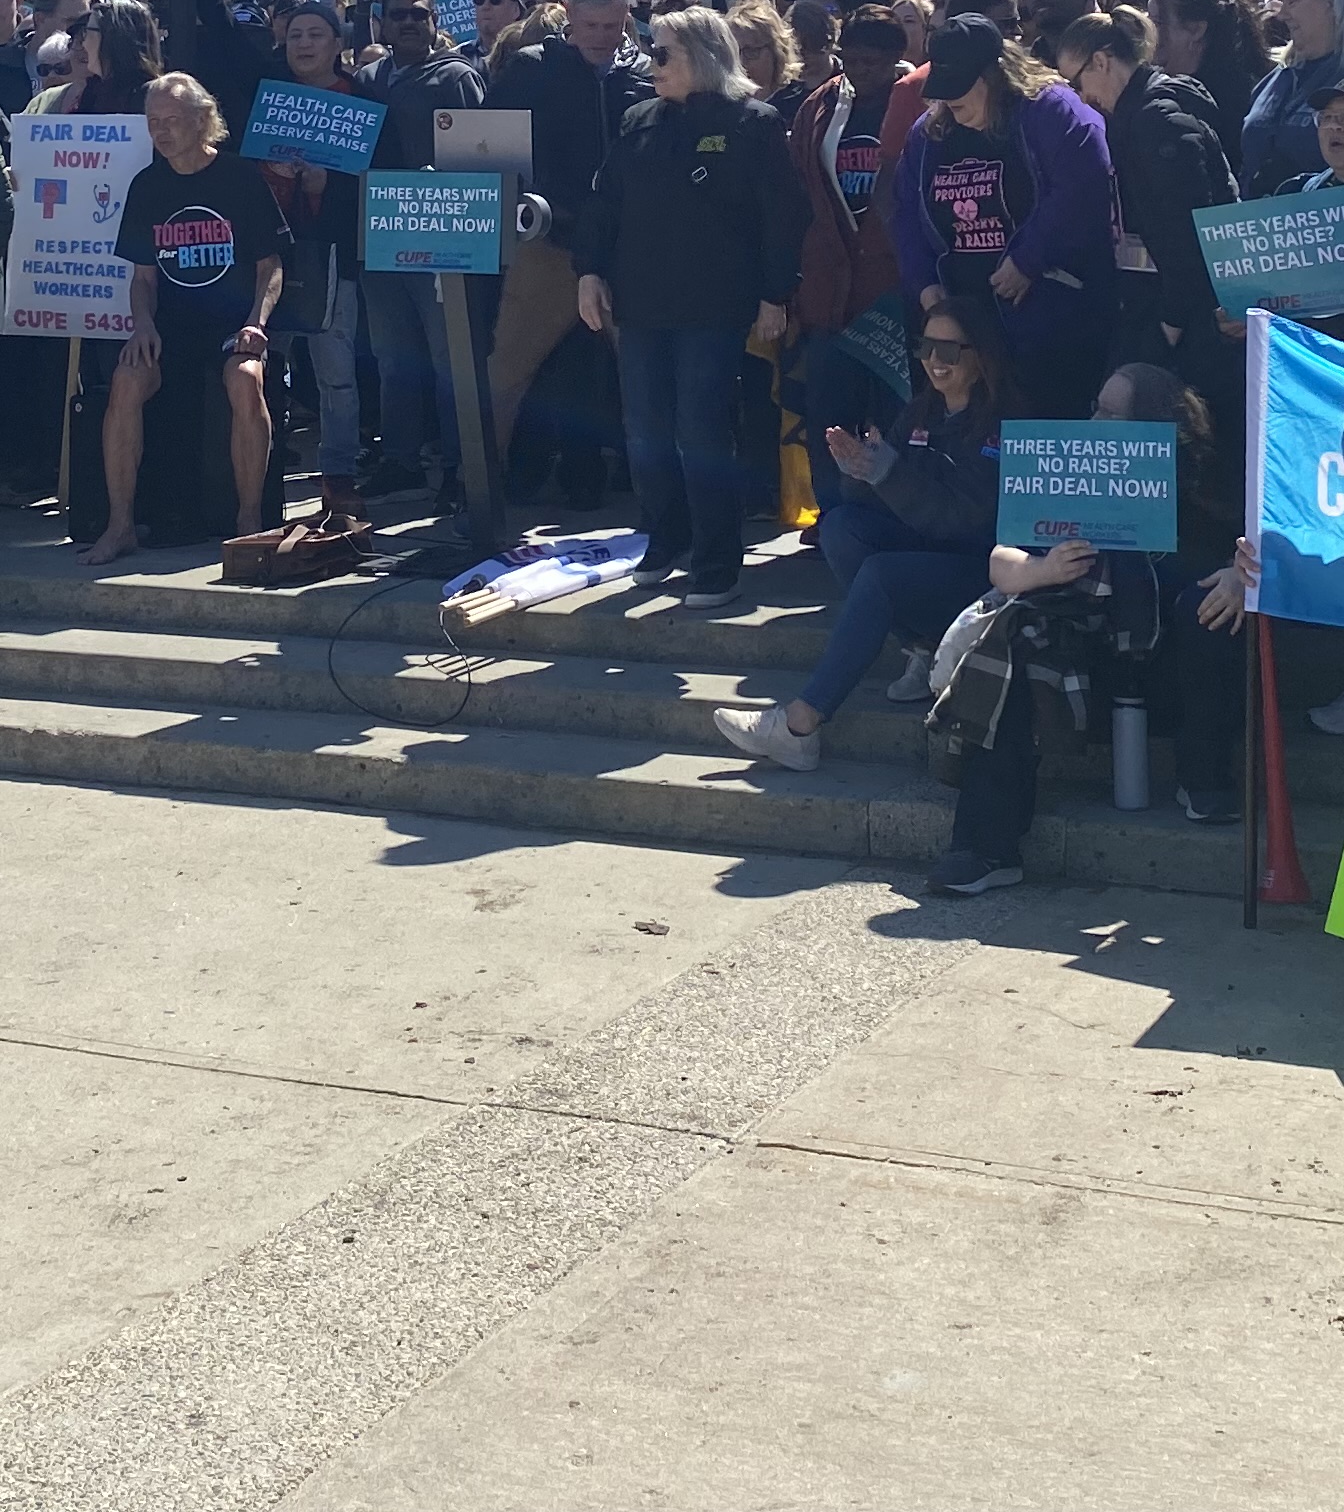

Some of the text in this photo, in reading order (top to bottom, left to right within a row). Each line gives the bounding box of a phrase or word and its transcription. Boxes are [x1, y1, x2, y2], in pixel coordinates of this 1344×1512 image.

[261, 91, 378, 127] HEALTH CARE
[266, 107, 363, 138] PROVIDERS
[31, 124, 132, 143] FAIR DEAL
[252, 122, 314, 141] DESERVE
[314, 132, 325, 143] A
[328, 135, 370, 154] RAISE
[53, 150, 111, 169] NOW!
[934, 169, 999, 187] HEALTH CARE
[370, 186, 498, 202] THREE YEARS WITH
[935, 183, 994, 202] PROVIDERS
[398, 201, 469, 215] NO RAISE?
[153, 219, 232, 247] TOGETHER
[370, 216, 495, 233] FAIR DEAL NOW!
[1201, 219, 1258, 242] THREE
[1260, 210, 1320, 233] YEARS
[35, 239, 115, 255] RESPECT
[966, 231, 1006, 249] RAISE!
[1242, 226, 1335, 254] NO RAISE?
[158, 243, 235, 270] for BETTER
[395, 250, 433, 264] CUPE
[1212, 257, 1256, 279] FAIR
[1260, 252, 1313, 273] DEAL
[22, 260, 127, 279] HEALTHCARE
[33, 280, 114, 299] WORKERS
[13, 309, 68, 330] CUPE
[1004, 439, 1171, 458] THREE YEARS WITH
[1037, 457, 1130, 475] NO RAISE?
[1004, 476, 1168, 499] FAIR DEAL NOW!
[1034, 520, 1081, 537] CUPE
